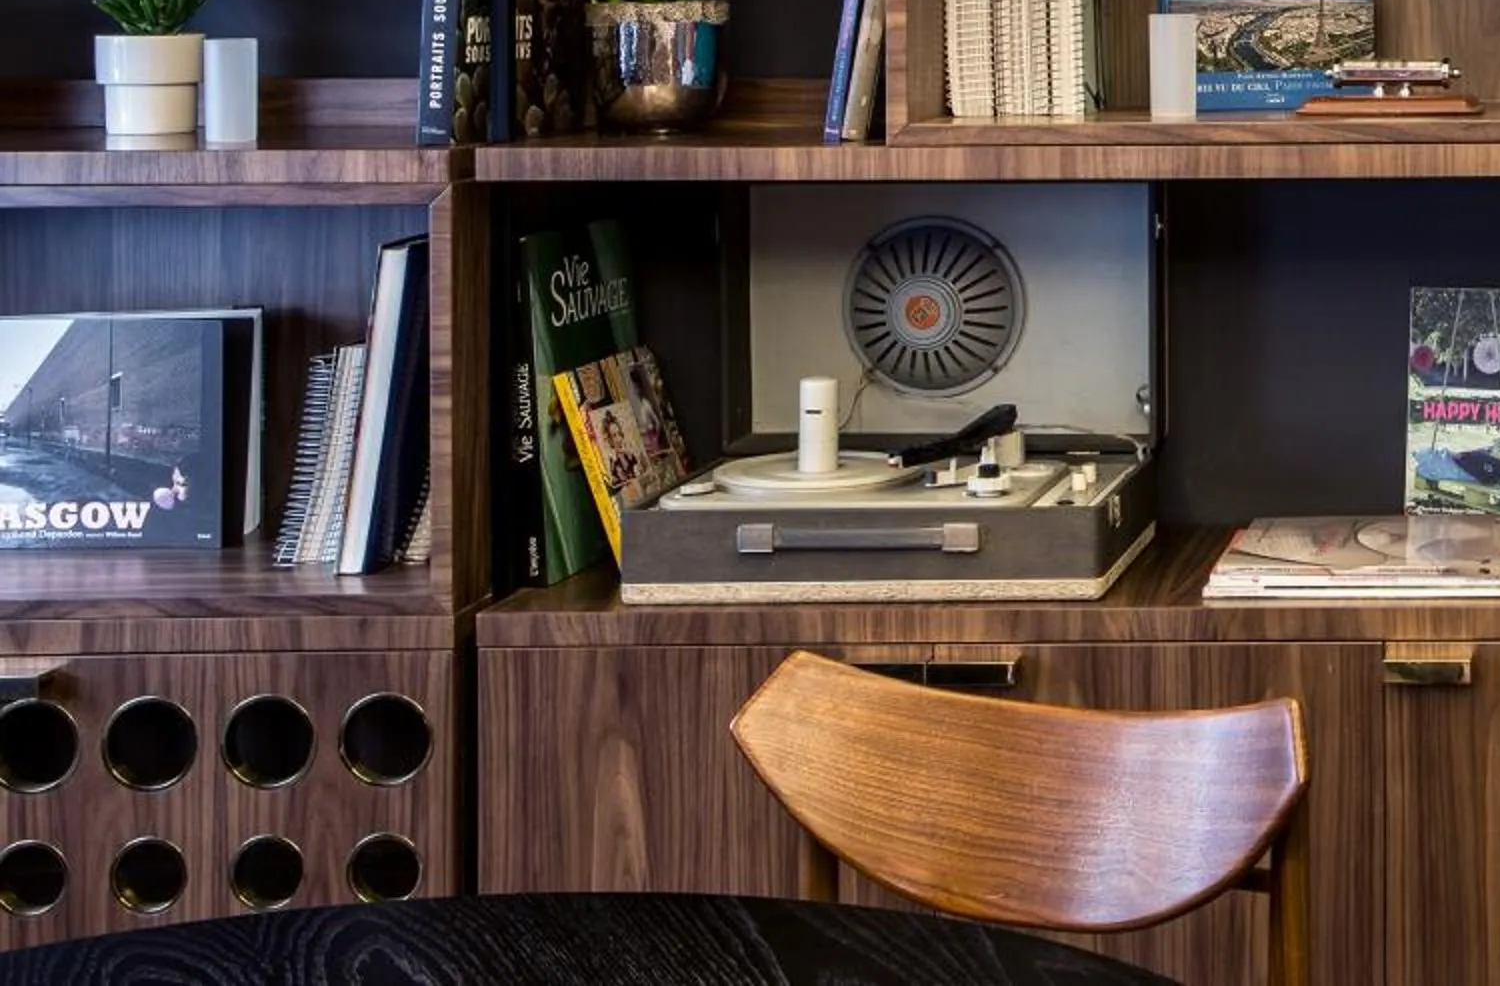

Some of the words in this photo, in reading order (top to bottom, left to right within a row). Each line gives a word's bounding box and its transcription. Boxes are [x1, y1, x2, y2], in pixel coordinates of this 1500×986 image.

[429, 31, 446, 110] PORTRAITS
[563, 254, 589, 287] Vie
[1423, 400, 1481, 421] HAPPY
[519, 436, 534, 464] Vie
